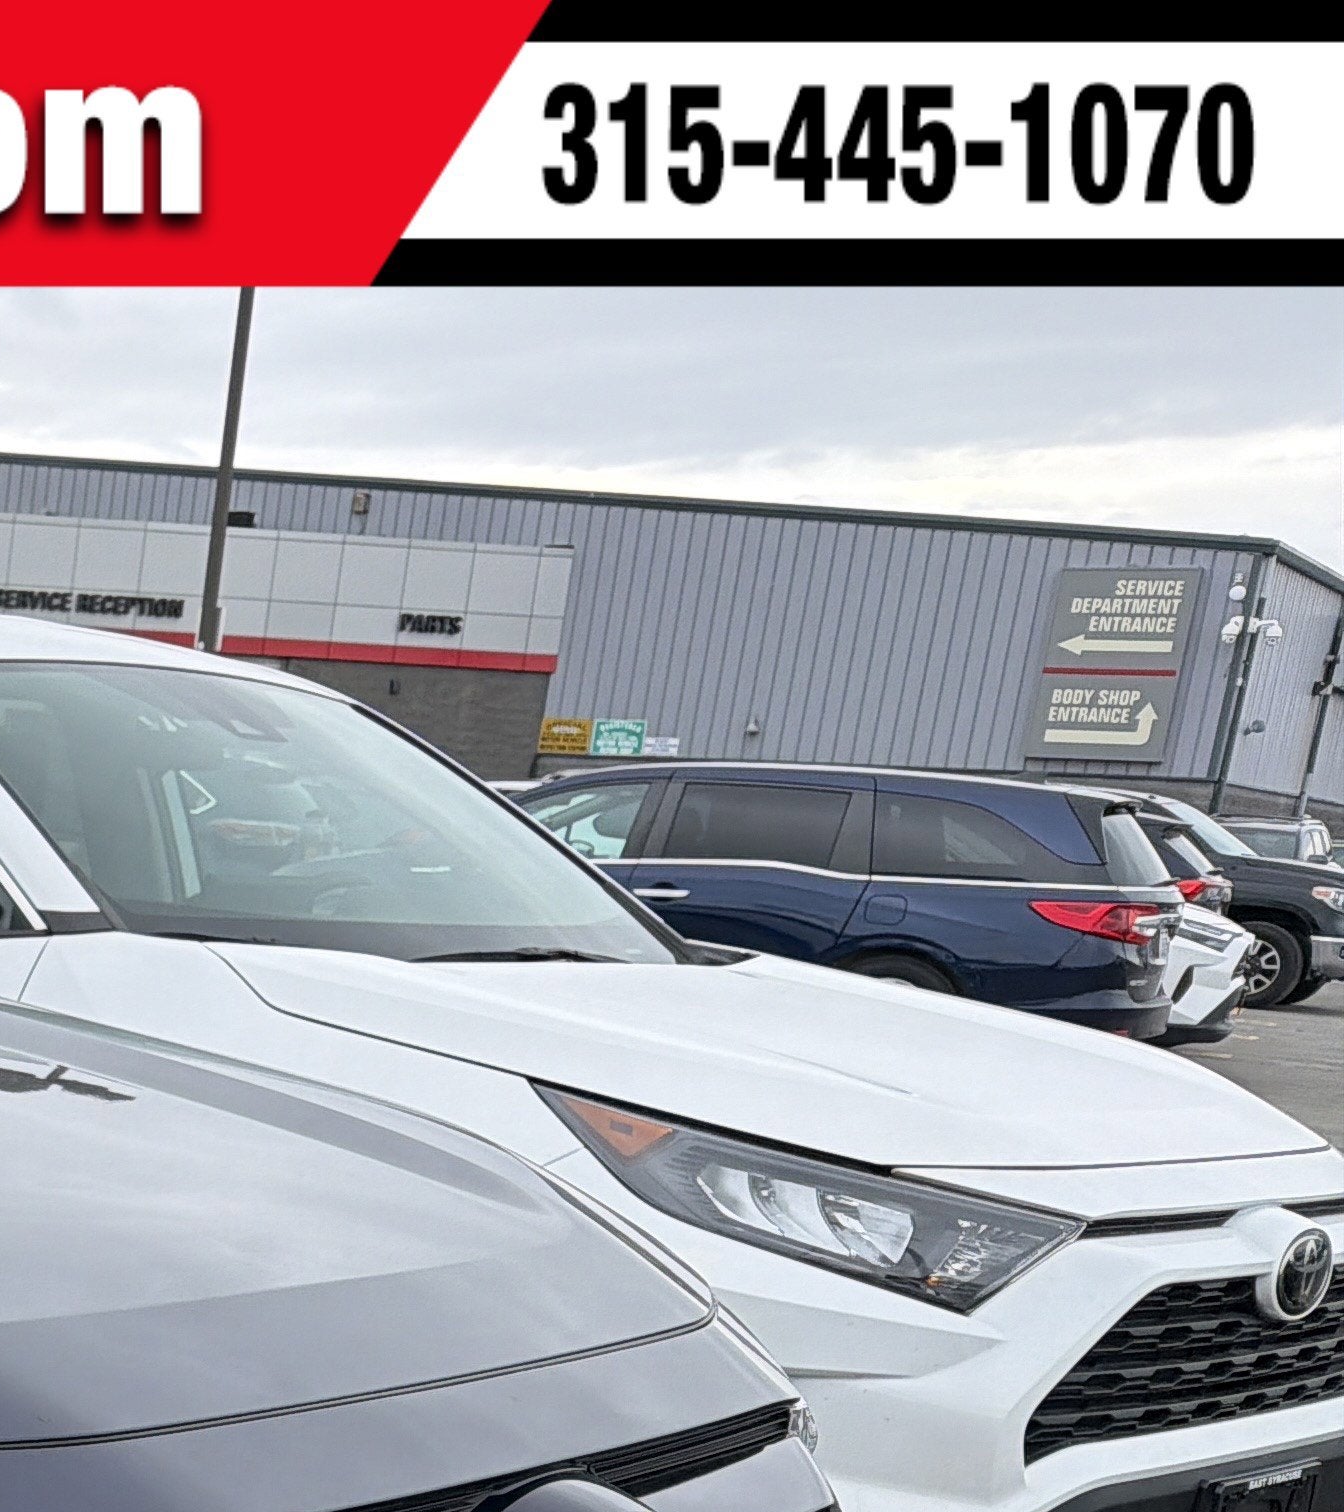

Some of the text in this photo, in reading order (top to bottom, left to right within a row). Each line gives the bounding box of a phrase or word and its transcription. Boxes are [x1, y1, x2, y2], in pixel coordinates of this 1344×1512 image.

[1116, 580, 1185, 596] SERVICE
[75, 593, 185, 618] RECEPTION
[1071, 599, 1182, 614] DEPARTMENT
[398, 613, 464, 635] PARTS
[1089, 617, 1177, 632] ENTRANCE
[1052, 689, 1141, 706] BODY SHOP
[1048, 707, 1131, 723] ENTRANCE
[1248, 1477, 1267, 1490] EAST
